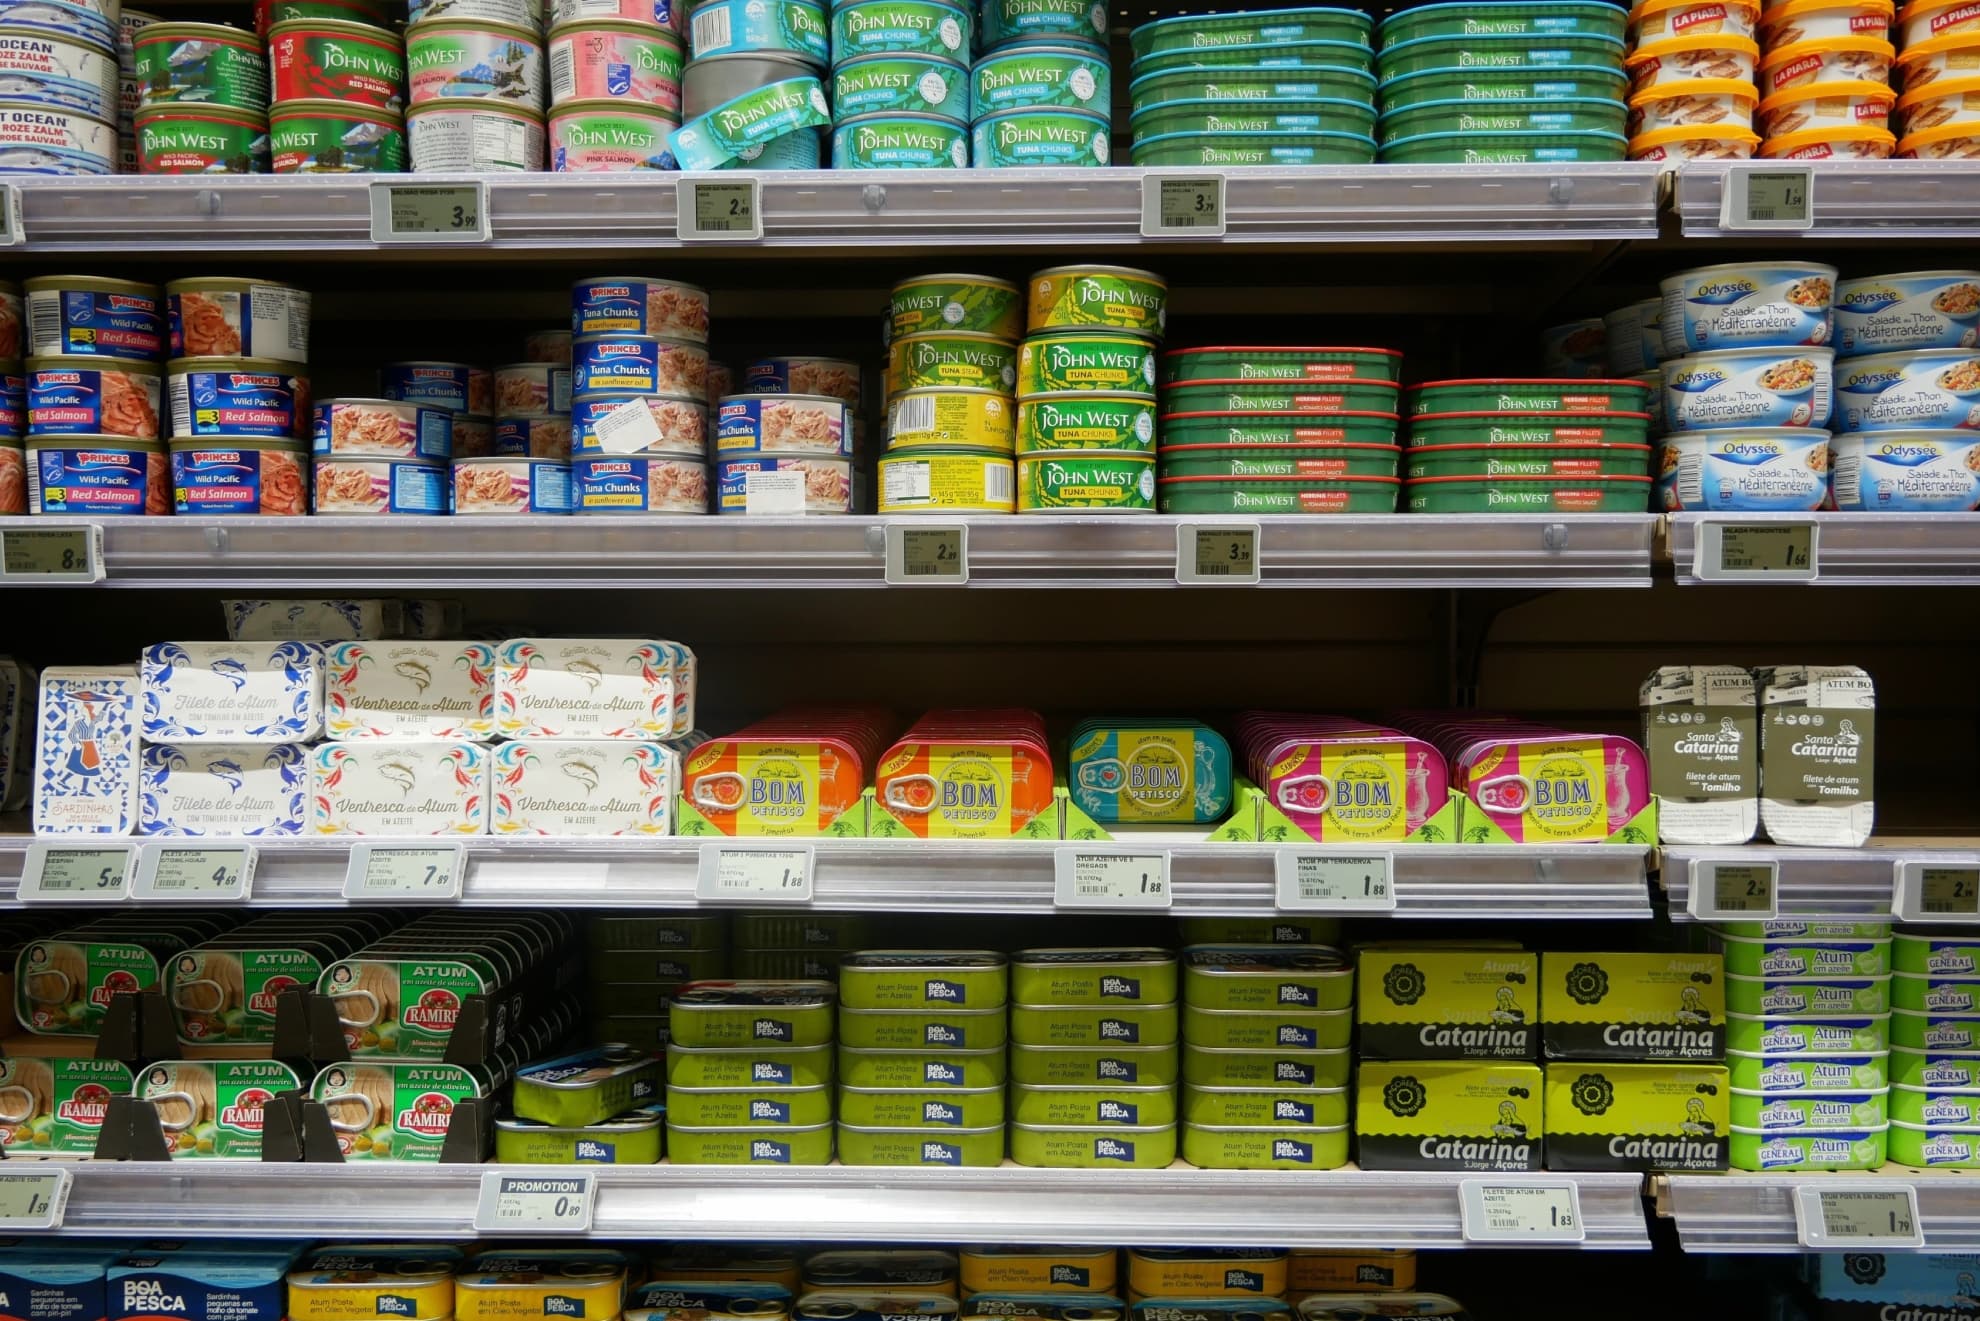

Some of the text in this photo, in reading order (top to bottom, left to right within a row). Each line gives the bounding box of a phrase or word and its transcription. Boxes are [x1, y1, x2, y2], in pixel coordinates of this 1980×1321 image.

[848, 14, 933, 31] JOHN WEST
[1675, 8, 1724, 27] LA PIARA
[1464, 23, 1526, 34] JOHN WEST
[861, 31, 917, 41] TUNA CHUNKS
[1774, 57, 1819, 86] LA PIARA
[11, 113, 67, 127] OCEAN
[2, 124, 63, 136] ROZE ZALM
[568, 129, 655, 148] JOHN WEST
[859, 132, 945, 150] JOHN WEST
[1001, 128, 1086, 144] JOHN WEST
[23, 137, 67, 147] SAUVAGE
[144, 132, 229, 152] JOHN WEST
[874, 151, 930, 160] TUNA CHUNKS
[1017, 146, 1072, 154] TUNA CHUNKS
[160, 158, 204, 167] RED SALMON
[607, 156, 635, 164] SALMON
[1698, 281, 1751, 298] Odyssée
[1845, 289, 1896, 304] Odyssée
[1721, 306, 1756, 317] Salade
[1768, 304, 1789, 315] Thon
[1712, 315, 1797, 329] Méditerranéenne
[1866, 312, 1936, 325] Salade Thon
[1858, 322, 1943, 337] Méditerranéenne
[598, 345, 641, 355] PRINCES
[1053, 352, 1138, 370] JOHN WEST
[591, 365, 649, 375] Tuna Chunks
[1070, 371, 1125, 380] TUNA CHUNKS
[232, 375, 280, 387] PRINCES
[602, 378, 631, 386] sunflower
[233, 398, 280, 408] Wild Pacific
[1498, 398, 1558, 410] JOHN WEST
[225, 413, 285, 423] Red Salmon
[1882, 443, 1937, 457] Odyssée
[77, 453, 129, 464] PRINCES
[591, 463, 631, 473] PRINCES
[79, 475, 128, 485] Wild Pacific
[1047, 470, 1133, 486] JOHN WEST
[585, 483, 640, 492] Tuna Chunks
[72, 489, 135, 501] Red Salmon
[1064, 489, 1119, 498] TUNA CHUNKS
[1234, 494, 1295, 507] JOHN WEST
[1711, 678, 1735, 688] ATUM
[175, 694, 278, 710] Filete de Atum
[521, 696, 590, 710] Ventresca
[604, 697, 645, 711] Atum
[1687, 732, 1716, 742] Santa
[1804, 735, 1833, 745] Santa
[1674, 740, 1739, 754] Catarina
[1792, 743, 1857, 757] Catarina
[1716, 753, 1738, 762] Açores
[1833, 756, 1856, 764] Açores
[1132, 765, 1180, 788] BOM
[1686, 772, 1741, 781] filete de atum
[1803, 775, 1859, 784] filete de atum
[751, 779, 805, 804] BOM
[1535, 779, 1591, 805] BOM
[1702, 782, 1741, 792] Tomilho
[1819, 785, 1859, 796] Tomilho
[943, 782, 996, 807] BOM
[1133, 790, 1180, 799] PETISCO
[1335, 781, 1391, 806] BOM
[752, 806, 804, 817] PETISCO
[944, 809, 996, 820] PETISCO
[1338, 808, 1391, 818] PETISCO
[1538, 805, 1591, 817] PETISCO
[99, 949, 145, 960] ATUM
[1814, 951, 1853, 964] Atum
[1764, 960, 1801, 970] GENERAL
[1827, 965, 1851, 973] azeite
[413, 966, 467, 978] ATUM
[1420, 1025, 1527, 1045] Catarina
[1494, 1046, 1525, 1056] Açores
[230, 1066, 283, 1076] ATUM
[928, 1071, 954, 1079] PESCA
[1925, 1108, 1965, 1117] GENERAL
[1098, 1141, 1115, 1149] BOA
[1608, 1138, 1718, 1159] Catarina
[1098, 1147, 1125, 1156] PESCA
[1684, 1158, 1716, 1169] Açores
[508, 1182, 578, 1192] PROMOTION
[124, 1282, 163, 1295] BOA
[124, 1296, 186, 1311] PESCA
[207, 1301, 240, 1309] pequenas
[380, 1303, 407, 1311] PESCA
